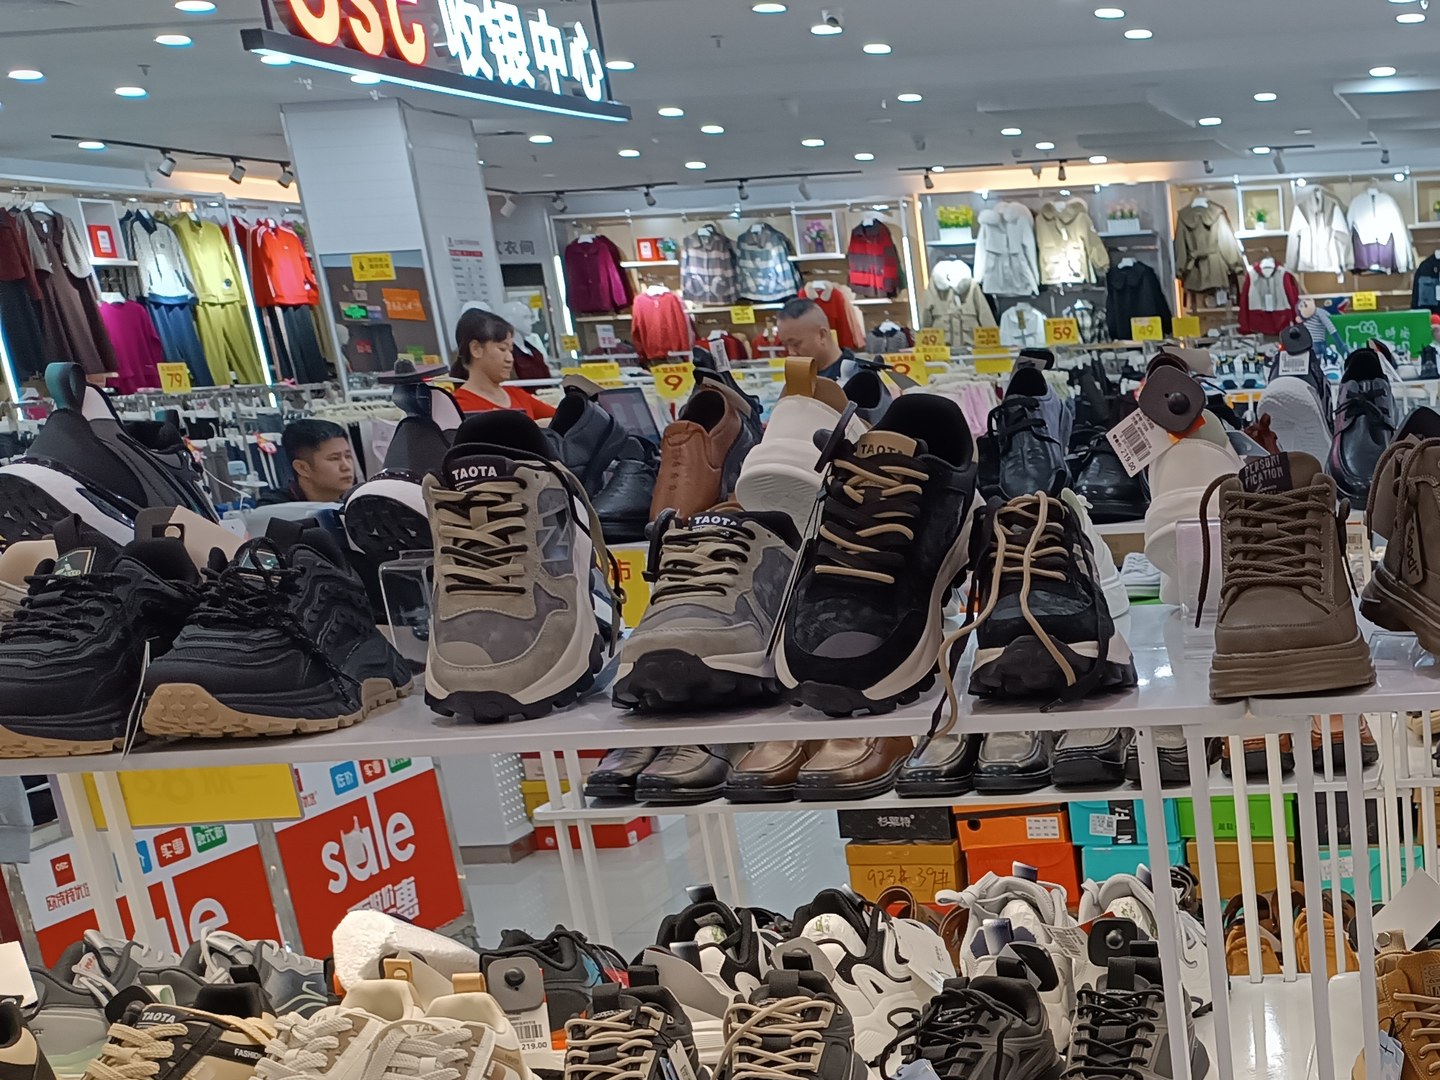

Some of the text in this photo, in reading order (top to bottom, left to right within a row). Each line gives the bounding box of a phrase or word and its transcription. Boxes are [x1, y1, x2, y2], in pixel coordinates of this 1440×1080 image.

[437, 0, 604, 101] 收银中心
[452, 465, 498, 481] TAOTA
[321, 796, 416, 894] sale
[141, 1011, 176, 1026] TAOTA
[521, 1041, 548, 1051] 219.00
